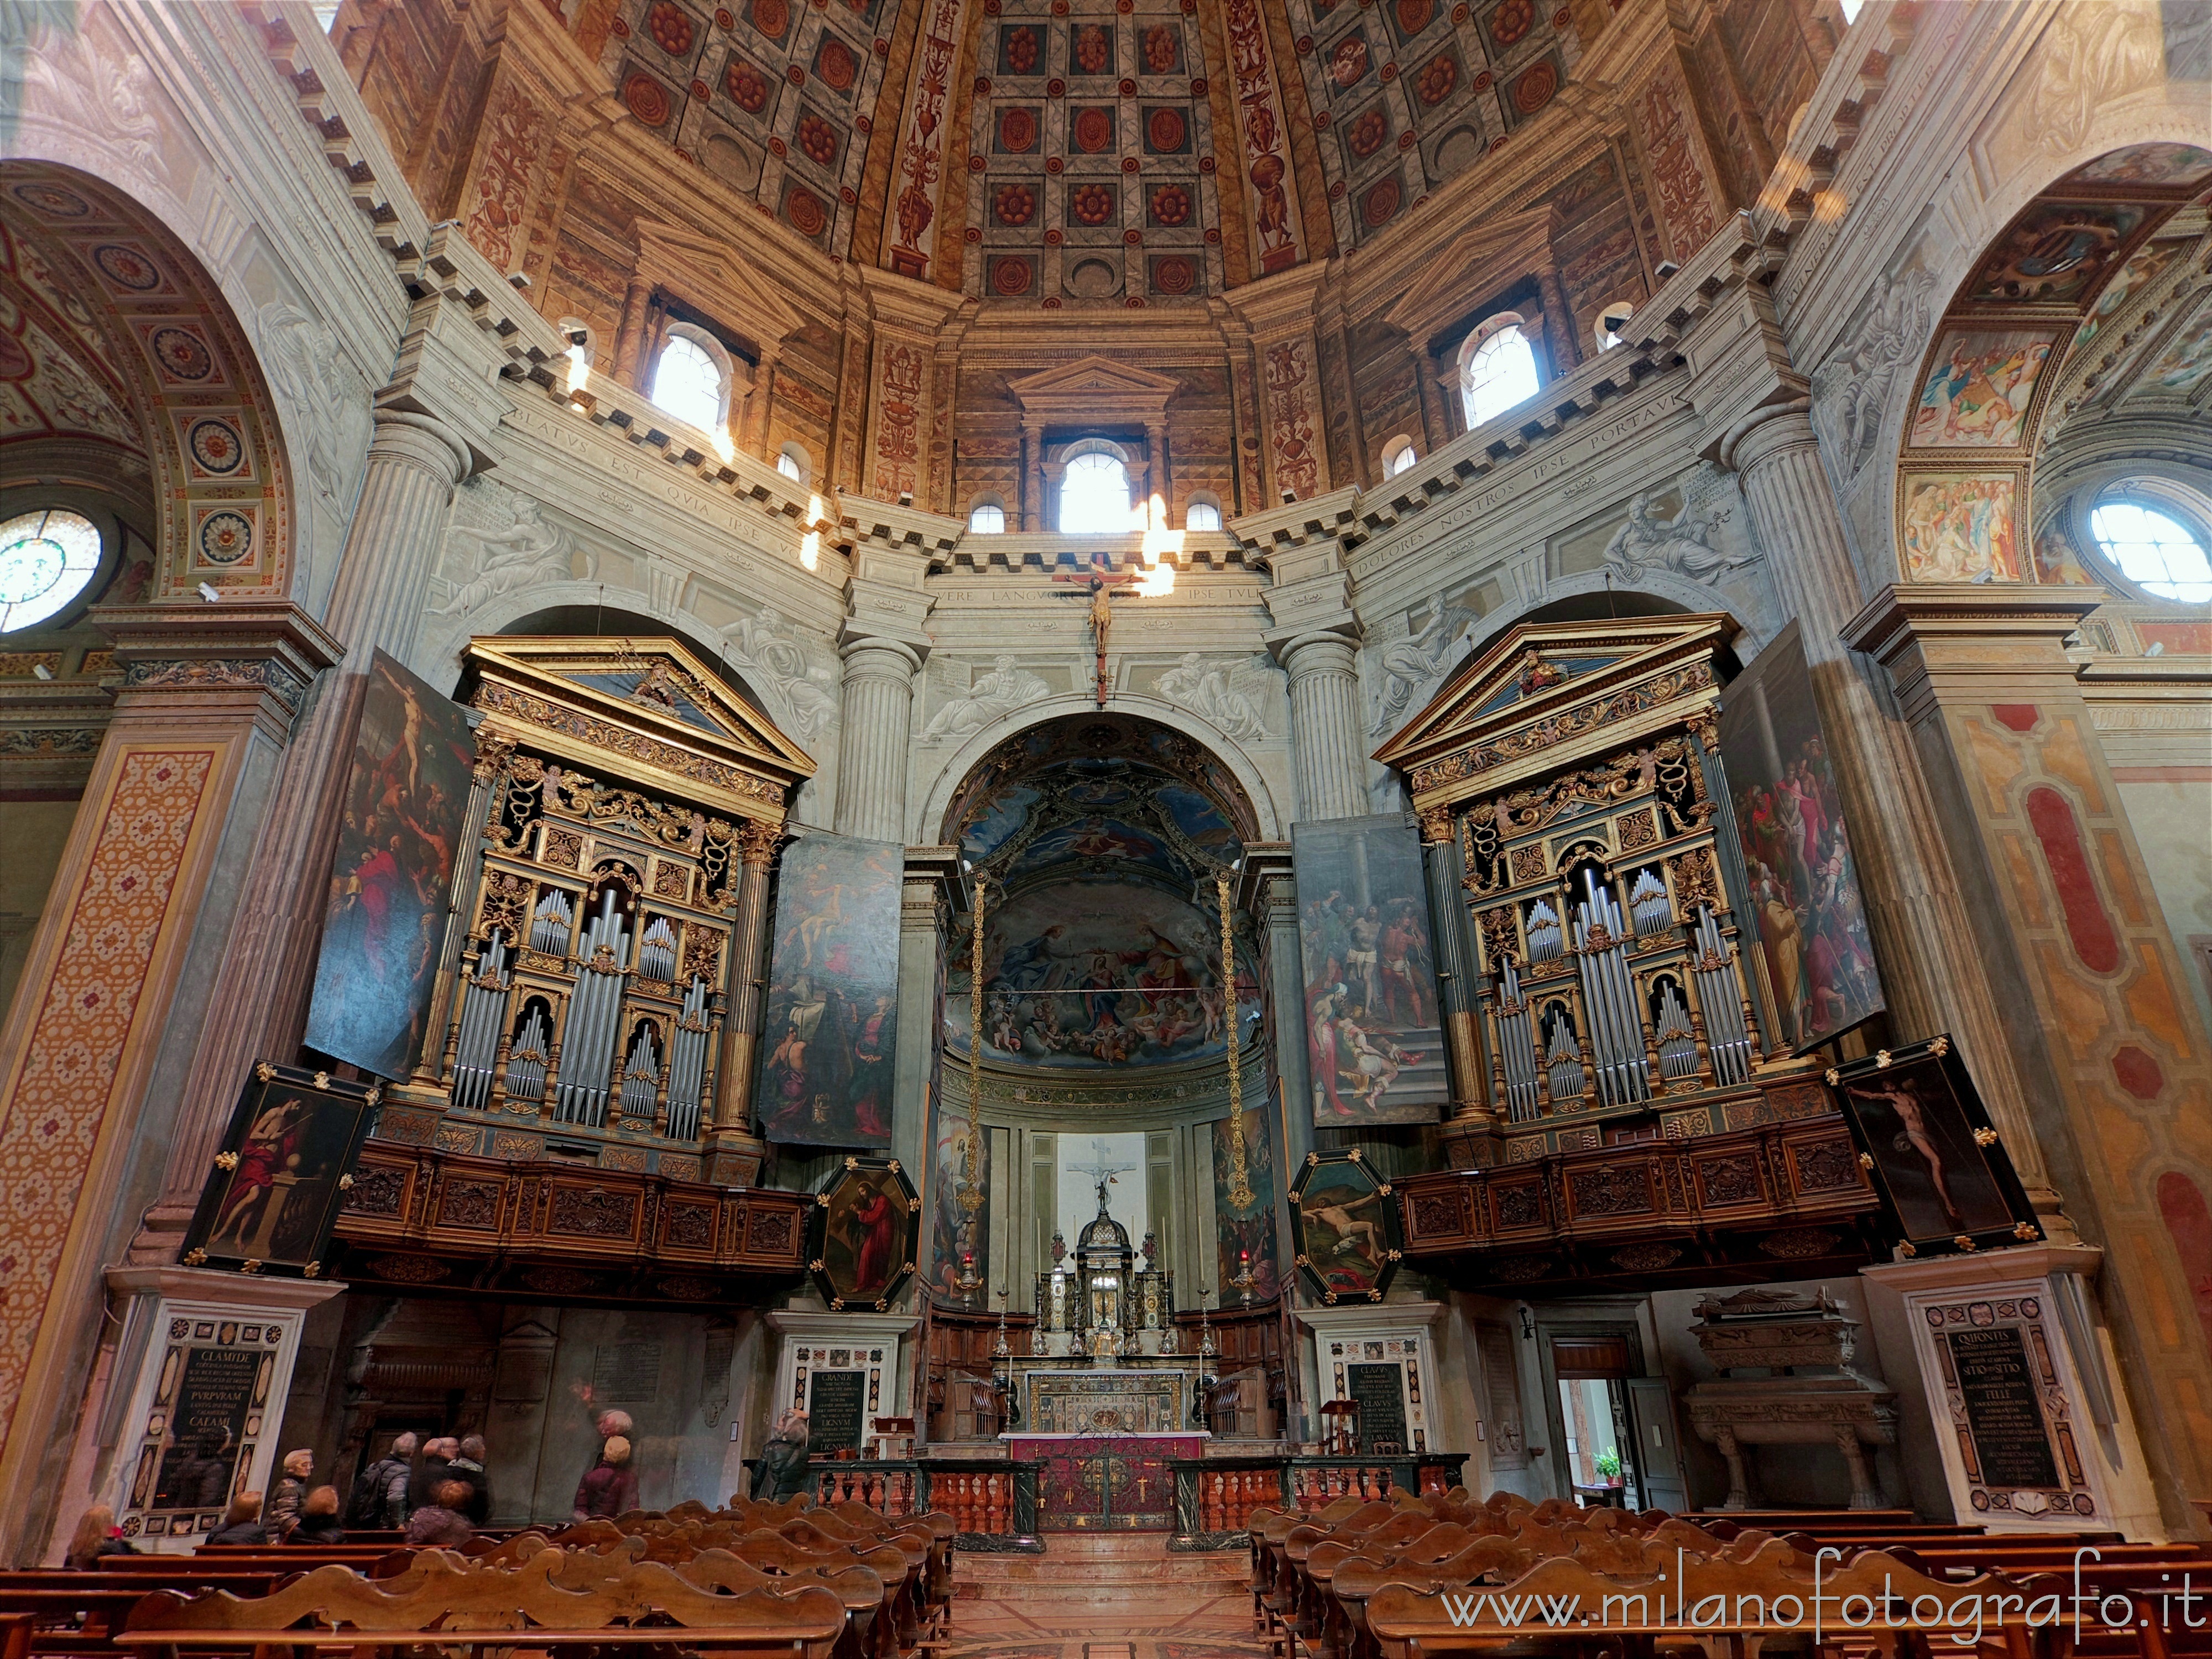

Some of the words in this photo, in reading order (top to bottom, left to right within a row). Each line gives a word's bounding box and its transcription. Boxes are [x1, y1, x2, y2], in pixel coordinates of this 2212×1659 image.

[611, 457, 644, 479] EST
[667, 487, 709, 516] QVIA
[728, 517, 760, 541] IPSE
[1358, 531, 1424, 573] DOLORES
[1441, 482, 1515, 530] NOSTROS
[1533, 453, 1569, 479] IPSE
[937, 591, 974, 601] VERE
[992, 590, 1084, 601] LANGVORES
[1189, 589, 1216, 599] IPSE
